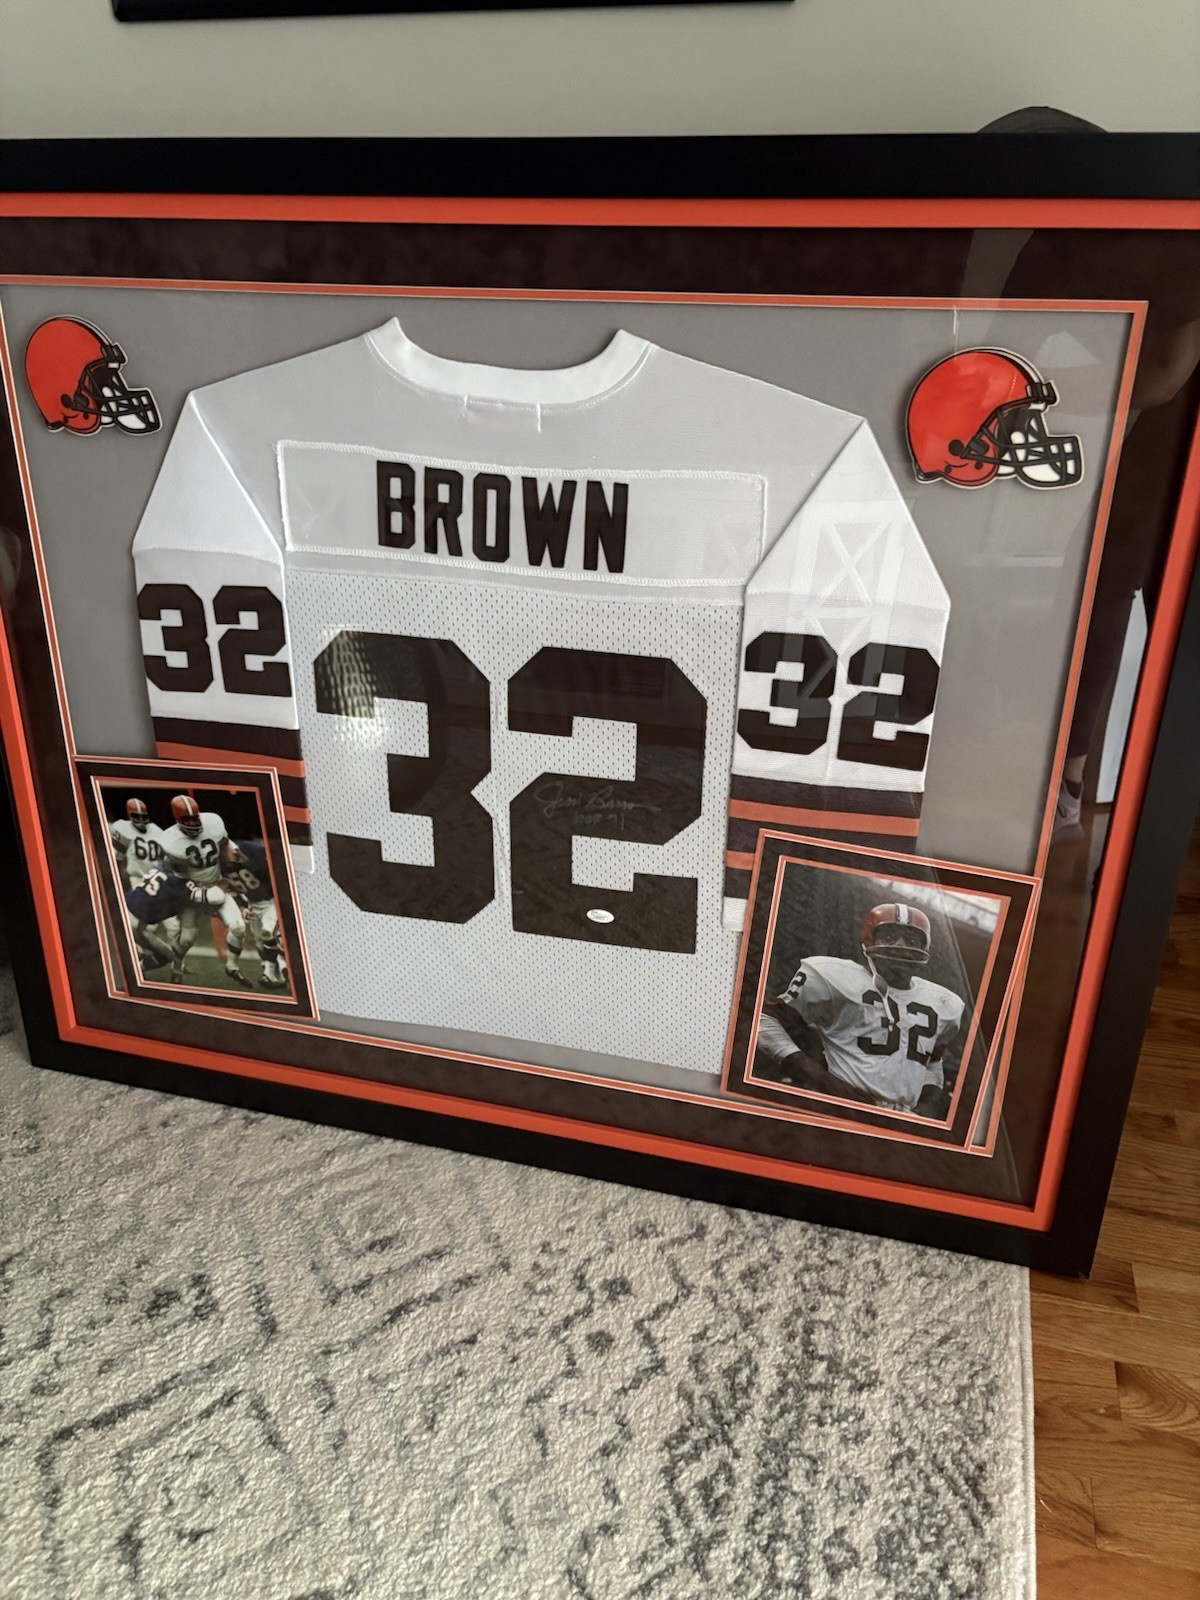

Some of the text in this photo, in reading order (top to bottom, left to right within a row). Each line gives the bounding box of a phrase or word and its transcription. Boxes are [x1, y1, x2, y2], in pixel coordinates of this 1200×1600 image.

[376, 460, 629, 573] BROWN
[137, 583, 292, 697] 32
[737, 631, 940, 772] 32
[313, 630, 708, 954] 32
[134, 836, 158, 862] 60
[185, 838, 217, 869] 32
[857, 989, 938, 1068] 32
